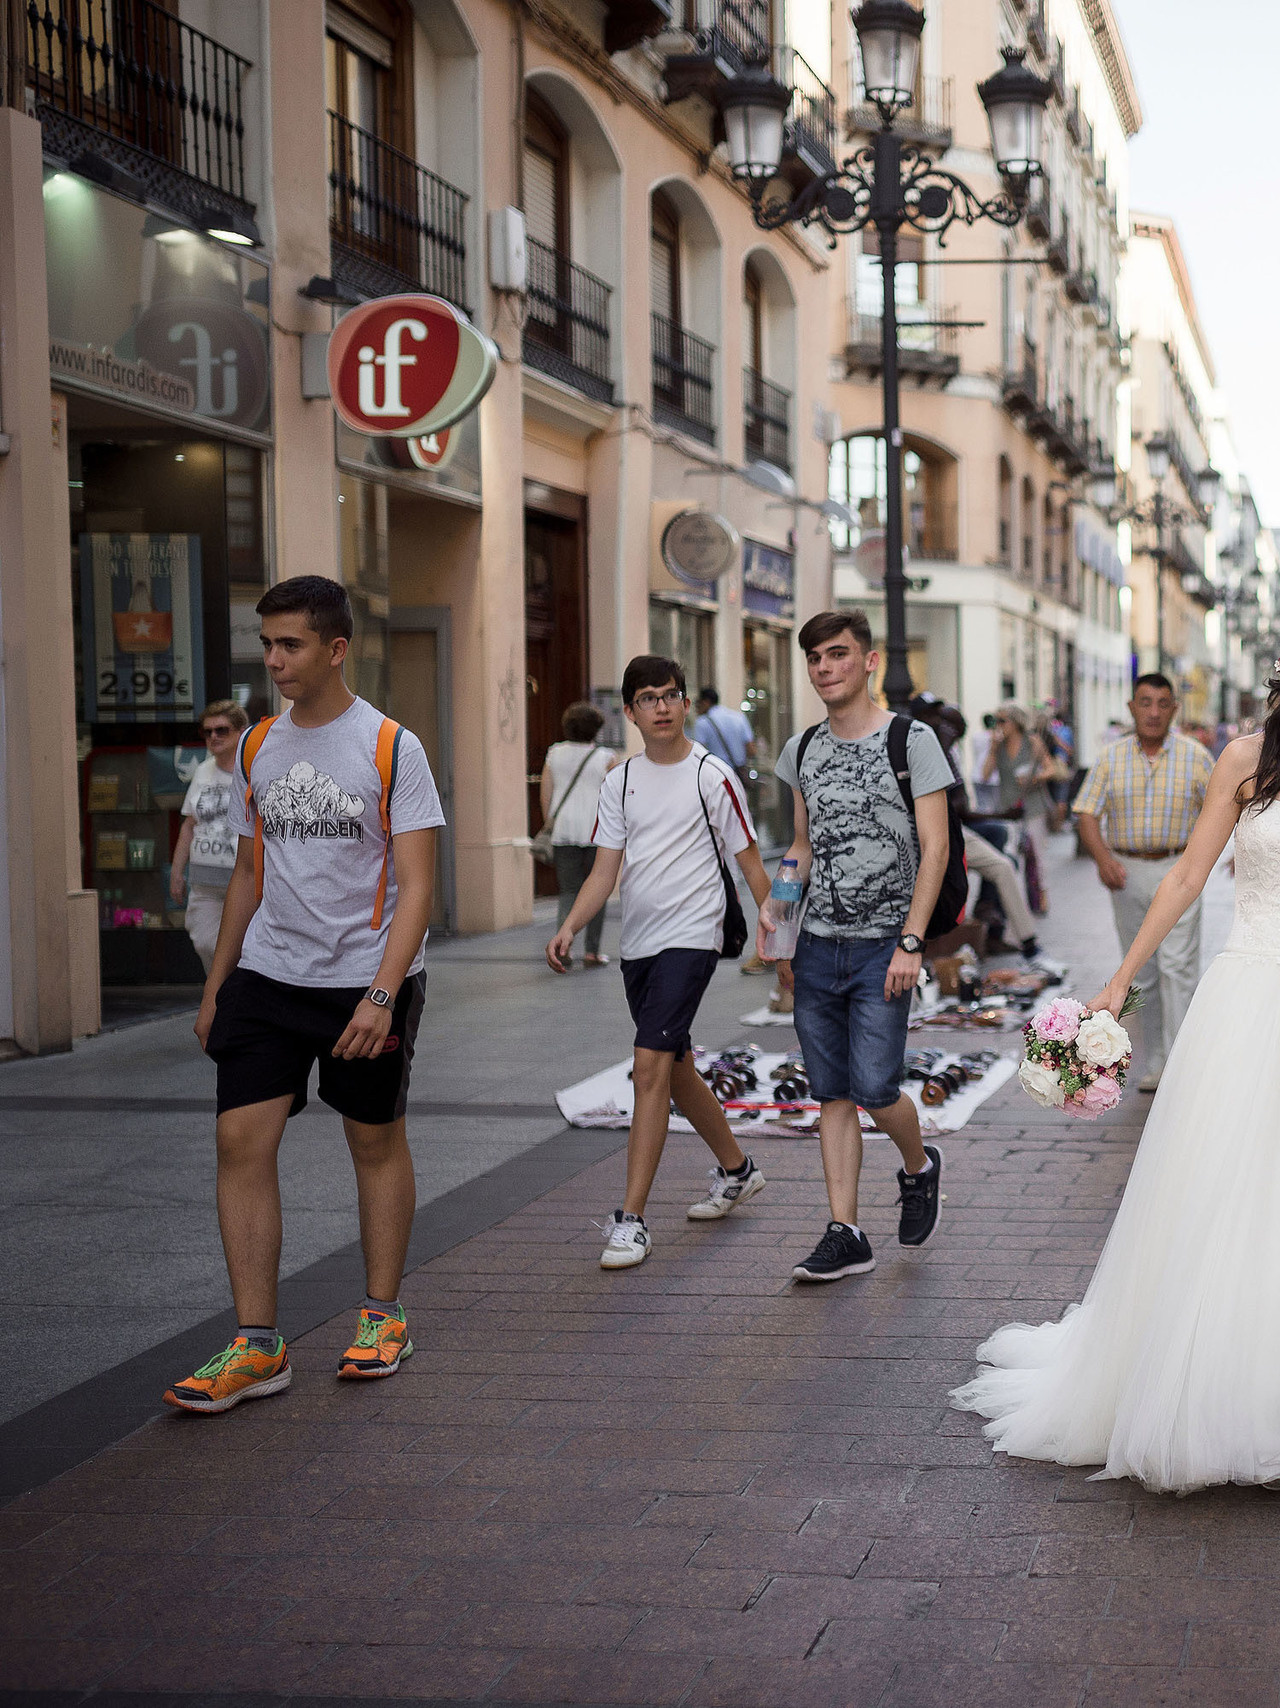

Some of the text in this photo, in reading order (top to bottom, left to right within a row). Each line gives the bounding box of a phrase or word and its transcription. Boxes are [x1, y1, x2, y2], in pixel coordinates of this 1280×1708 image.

[357, 318, 428, 417] if
[263, 818, 364, 844] ON MAIDEN
